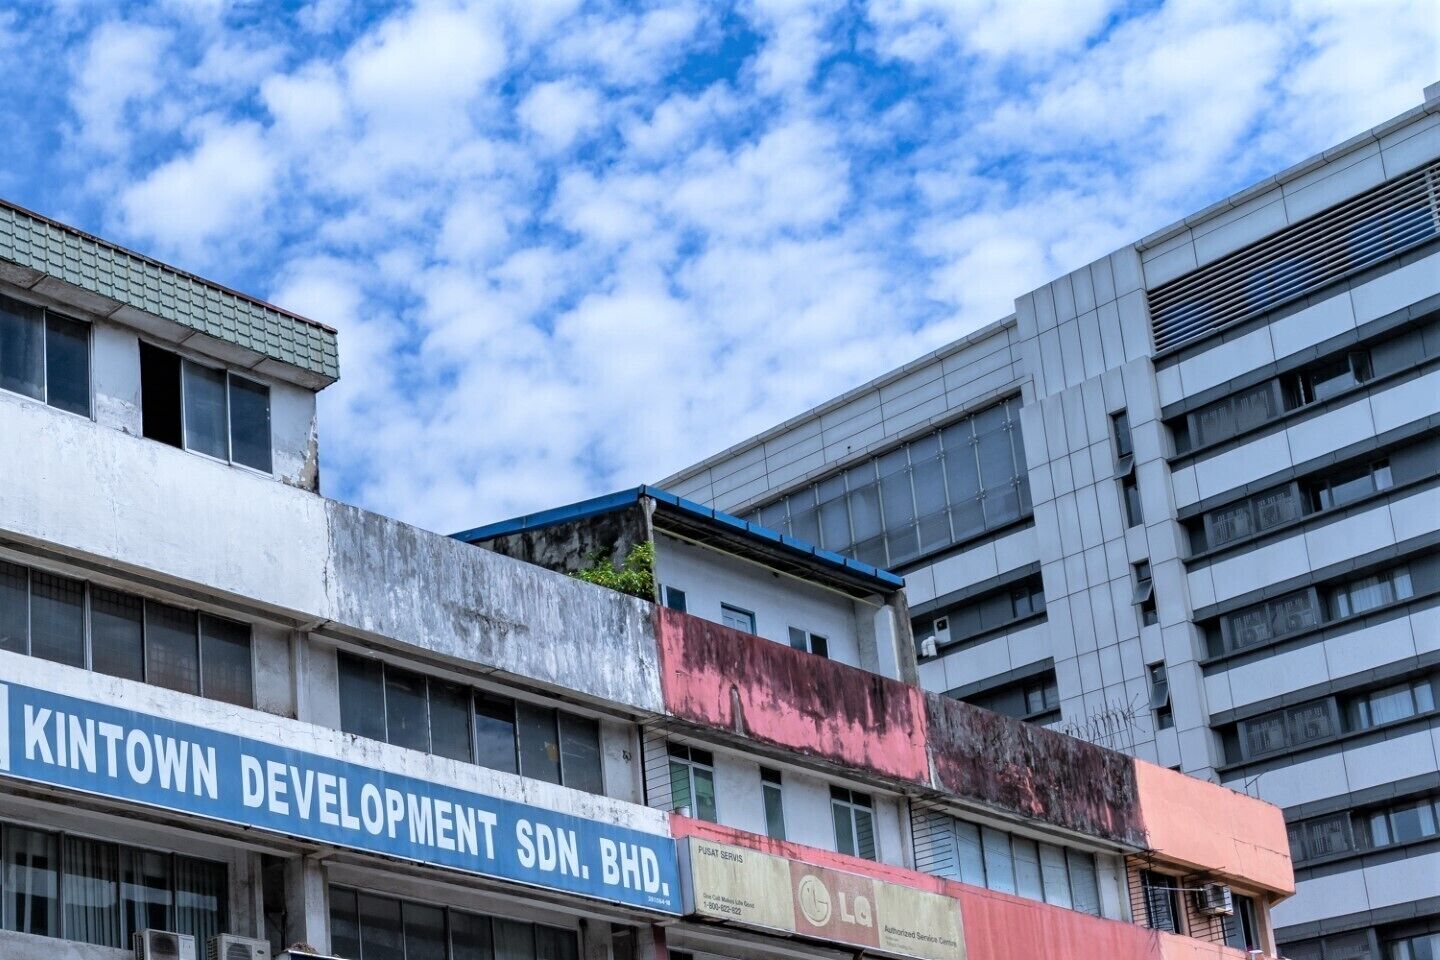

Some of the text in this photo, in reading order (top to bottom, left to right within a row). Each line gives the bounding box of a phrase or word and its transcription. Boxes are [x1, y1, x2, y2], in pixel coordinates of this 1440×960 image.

[24, 704, 670, 896] KINTOWN DEVELOPMENT SDN. BHD.
[698, 845, 744, 863] PUSAT SERVIS
[884, 925, 916, 939] Authorized
[917, 931, 938, 943] Service
